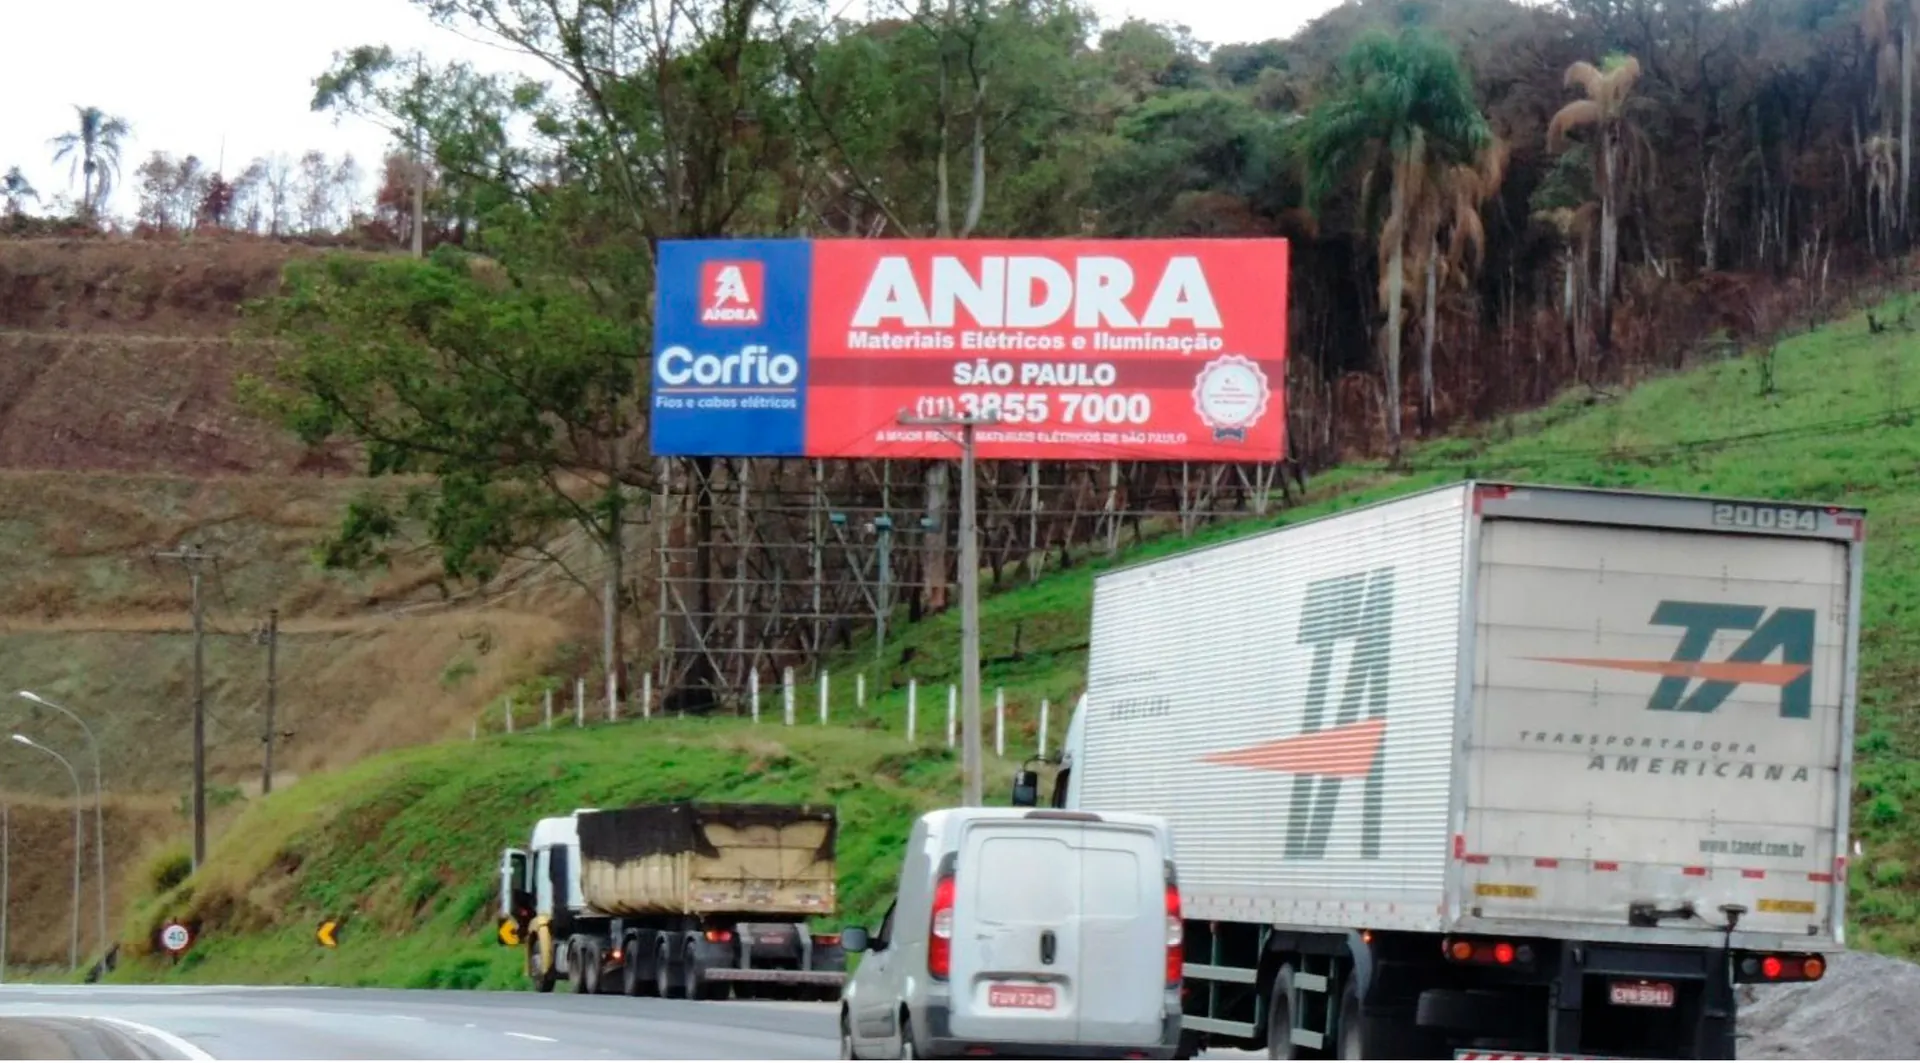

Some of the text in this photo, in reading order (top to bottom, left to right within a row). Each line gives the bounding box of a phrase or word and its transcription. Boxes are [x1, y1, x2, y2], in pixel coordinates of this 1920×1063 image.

[850, 256, 1224, 328] ANDRA
[702, 308, 758, 321] ANDRA
[848, 331, 1223, 354] Materiais Elétricos e Iluminação
[657, 344, 798, 385] Corfio
[954, 359, 1115, 386] SÃO PAULO
[656, 395, 796, 409] Fios e cabos elétricos
[916, 392, 1151, 424] (11) 3855 7000
[1121, 429, 1146, 443] SÃO
[1148, 432, 1187, 443] PAULO
[1714, 504, 1816, 531] 20094
[1645, 600, 1816, 719] TA
[1519, 730, 1757, 755] TRANSPORTADORA
[1586, 754, 1809, 782] AMERICANA
[168, 931, 185, 942] 40
